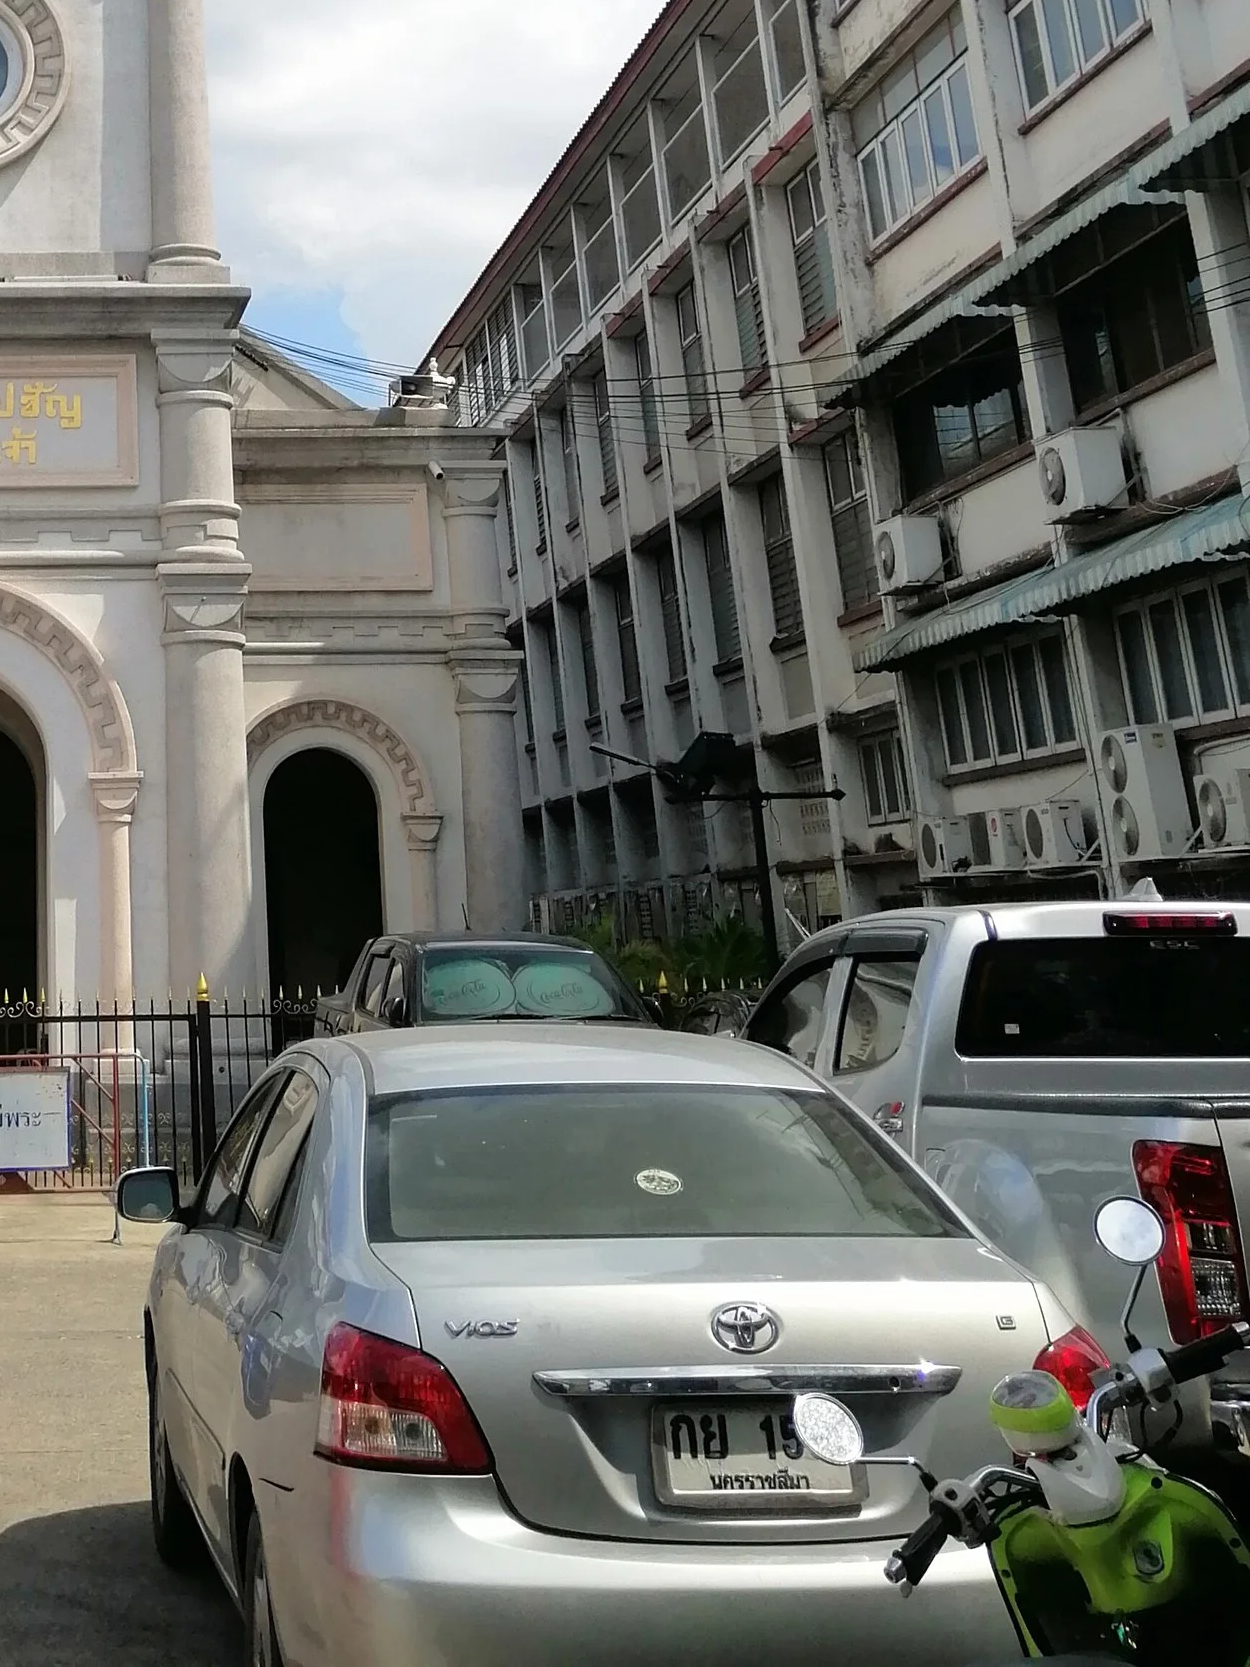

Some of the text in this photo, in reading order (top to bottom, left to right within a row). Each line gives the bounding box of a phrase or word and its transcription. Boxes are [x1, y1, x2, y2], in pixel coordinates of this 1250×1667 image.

[443, 1317, 521, 1339] VIOS
[668, 1413, 730, 1460] กย
[710, 1468, 811, 1491] นครราชสีมา
